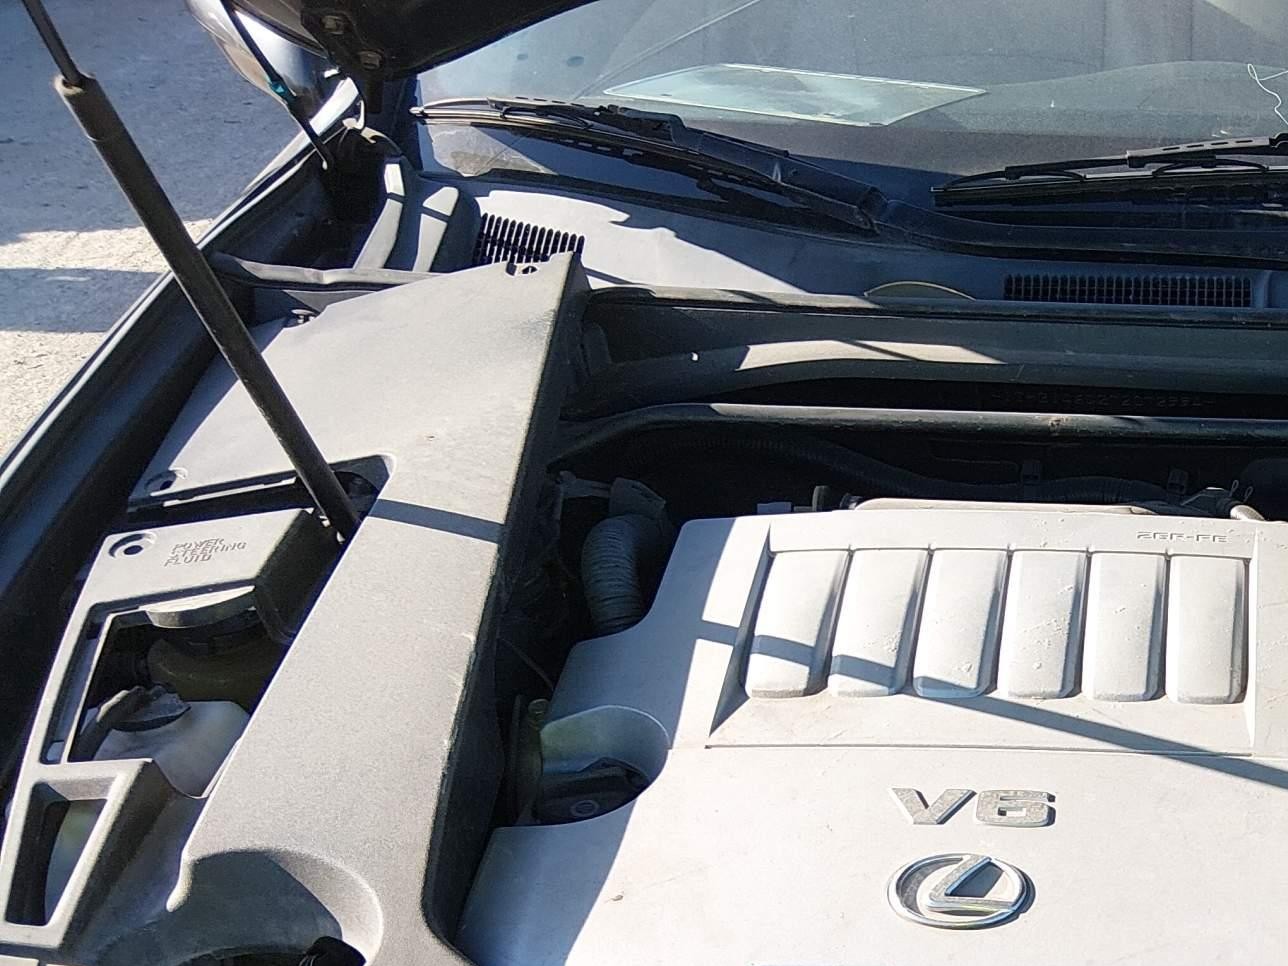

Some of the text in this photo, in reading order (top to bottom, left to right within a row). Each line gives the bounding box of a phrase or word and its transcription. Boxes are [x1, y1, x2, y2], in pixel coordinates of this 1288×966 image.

[169, 542, 247, 560] STEERING
[171, 538, 224, 554] POWER
[164, 554, 212, 567] FLUID
[888, 787, 1057, 828] V6
